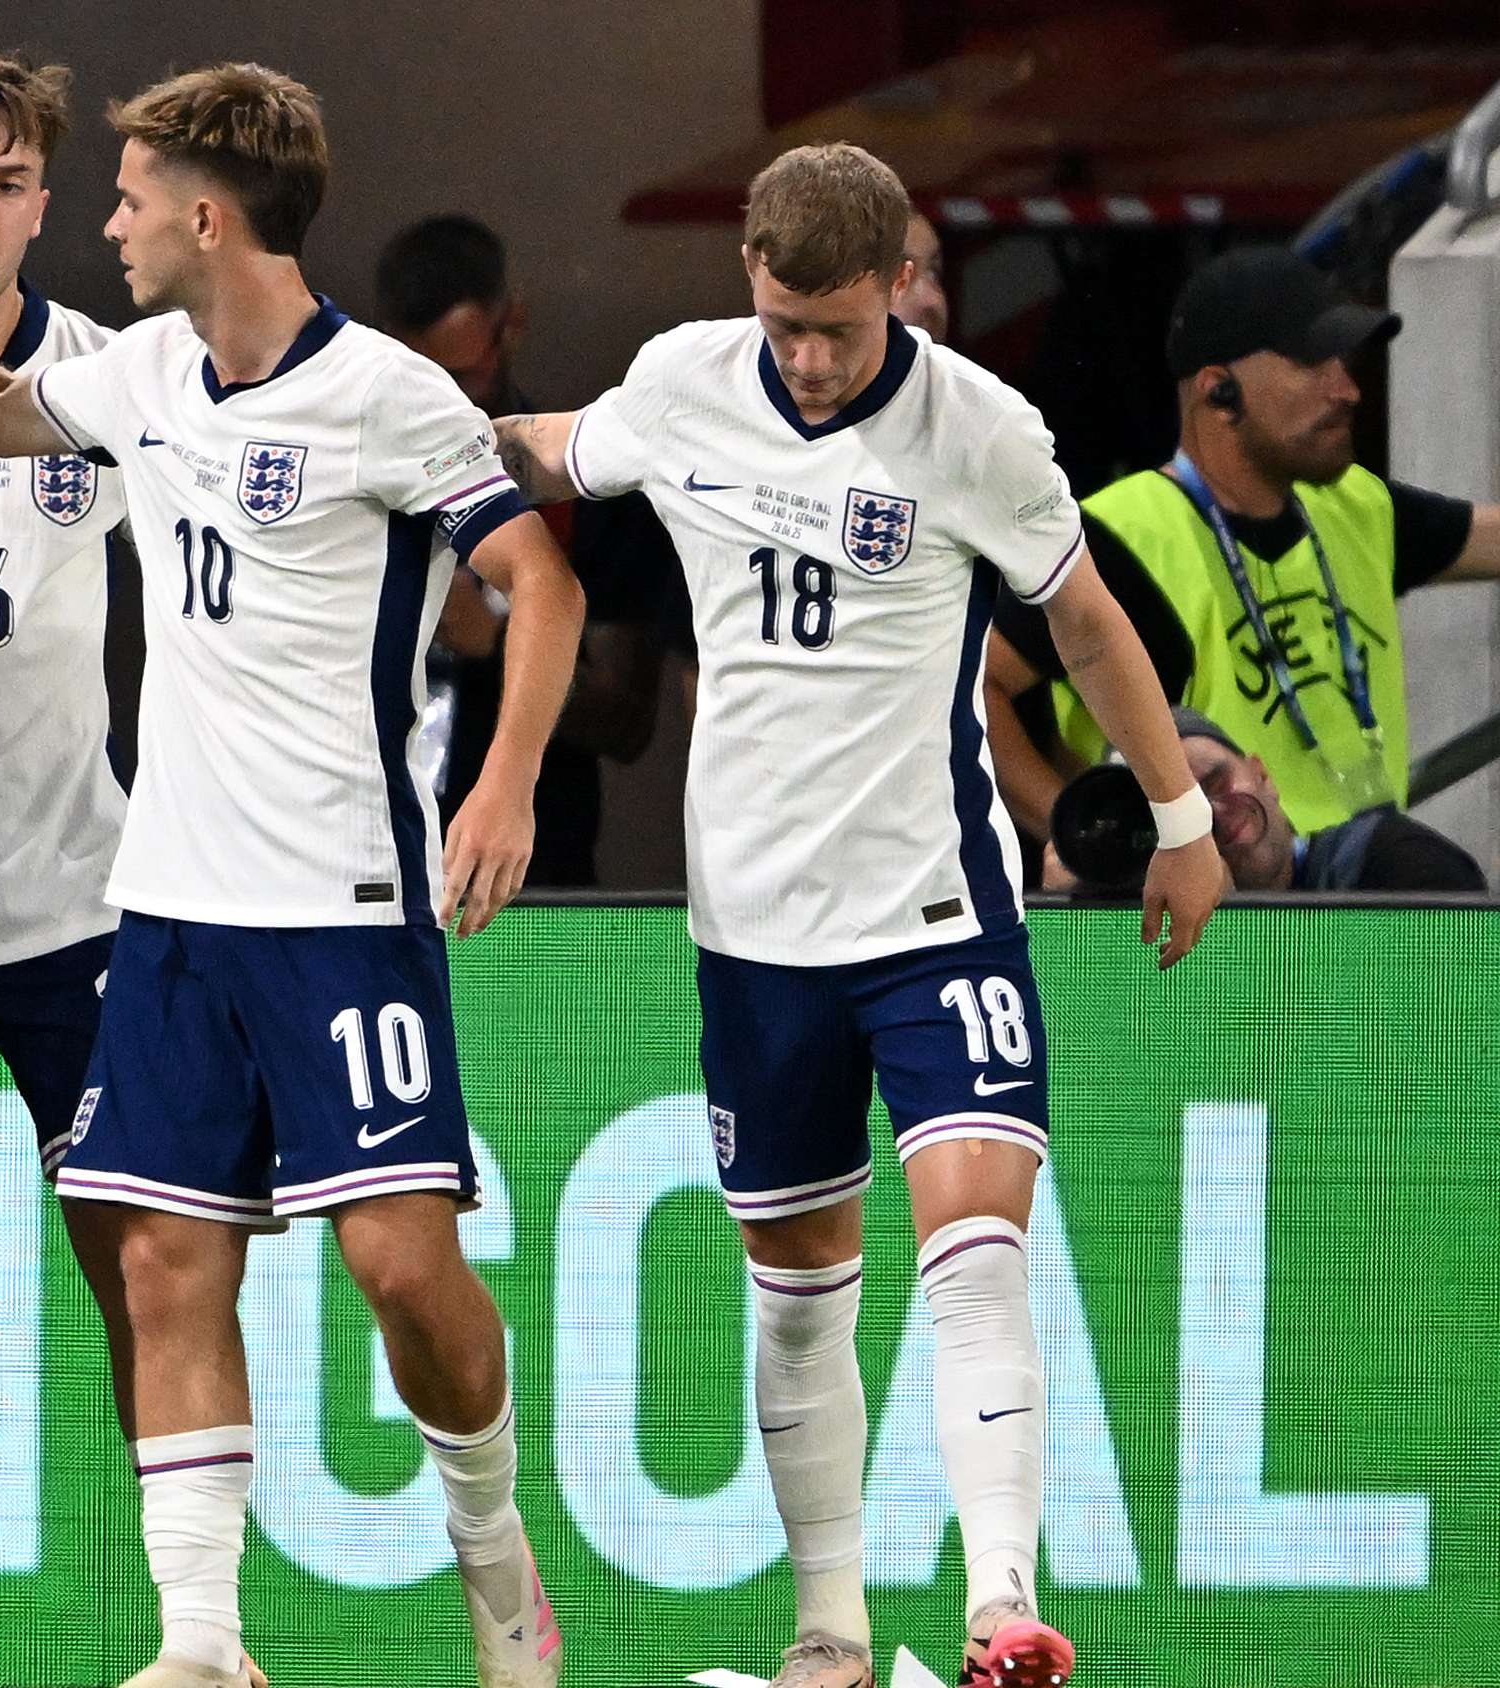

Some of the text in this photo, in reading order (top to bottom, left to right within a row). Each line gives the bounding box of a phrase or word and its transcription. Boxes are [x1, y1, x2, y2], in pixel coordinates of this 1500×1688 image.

[752, 501, 786, 522] ENGLAND
[795, 512, 829, 532] GERMANY
[755, 484, 832, 516] UEFA U21 EURO FINAL
[175, 517, 235, 625] 10
[749, 546, 837, 651] 18
[330, 1002, 431, 1109] 10
[939, 975, 1032, 1067] 18
[238, 1093, 1431, 1591] GOAL
